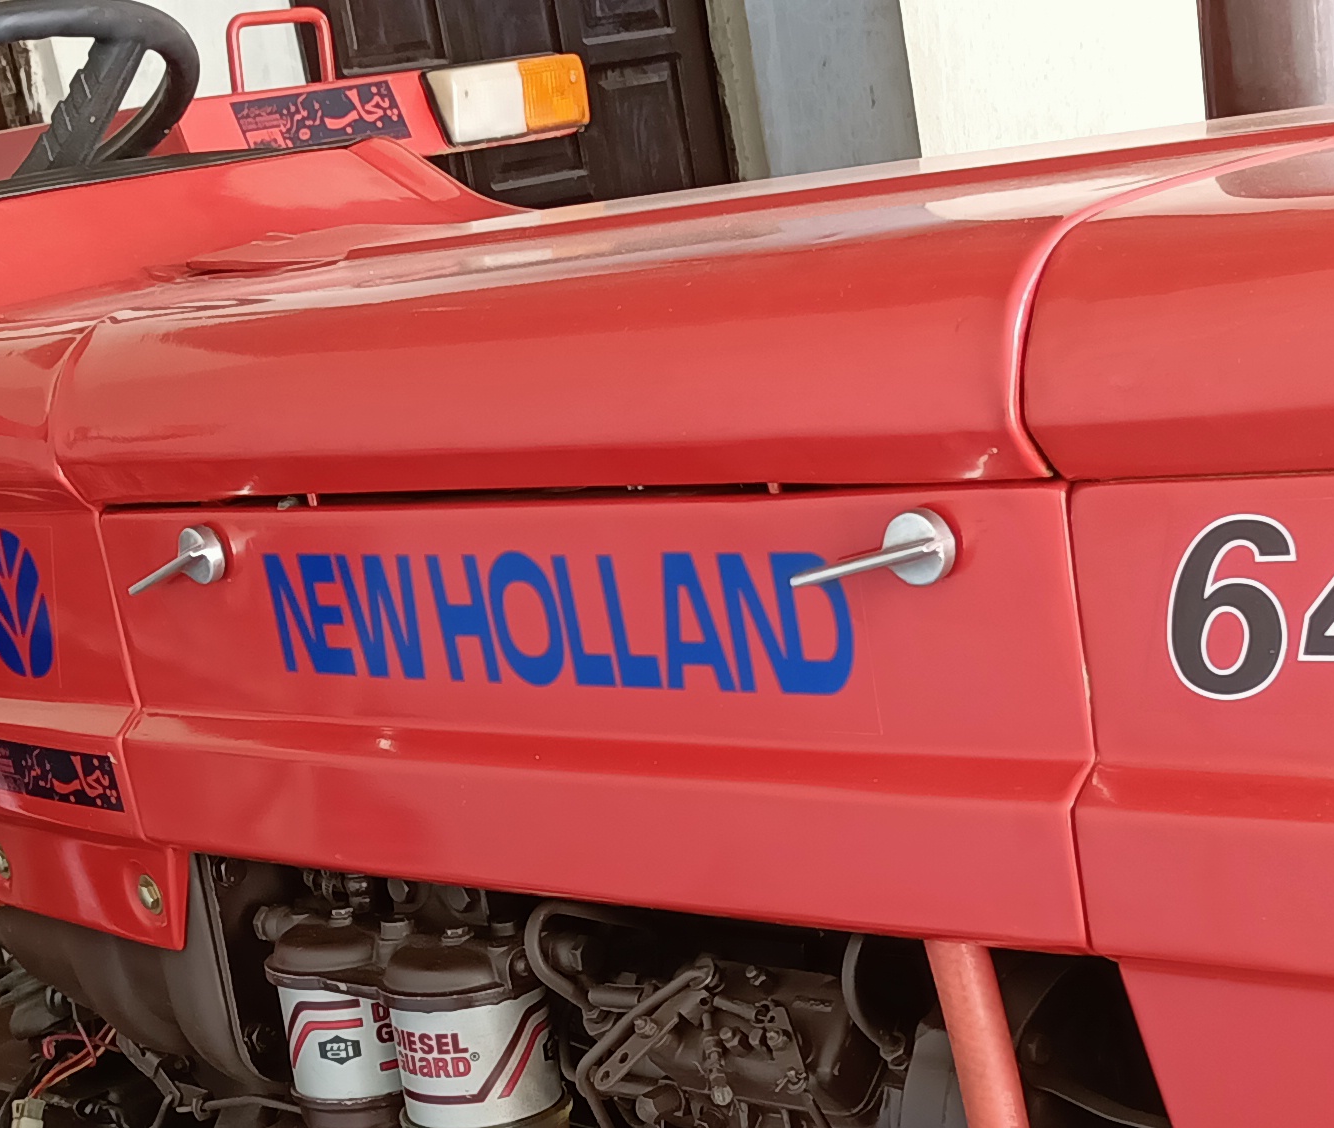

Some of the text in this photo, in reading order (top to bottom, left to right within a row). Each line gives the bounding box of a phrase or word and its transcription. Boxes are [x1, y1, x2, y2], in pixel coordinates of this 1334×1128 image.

[323, 86, 399, 134] پنجاب
[263, 552, 853, 695] NEW HOLLAND
[52, 755, 117, 807] پنجاب
